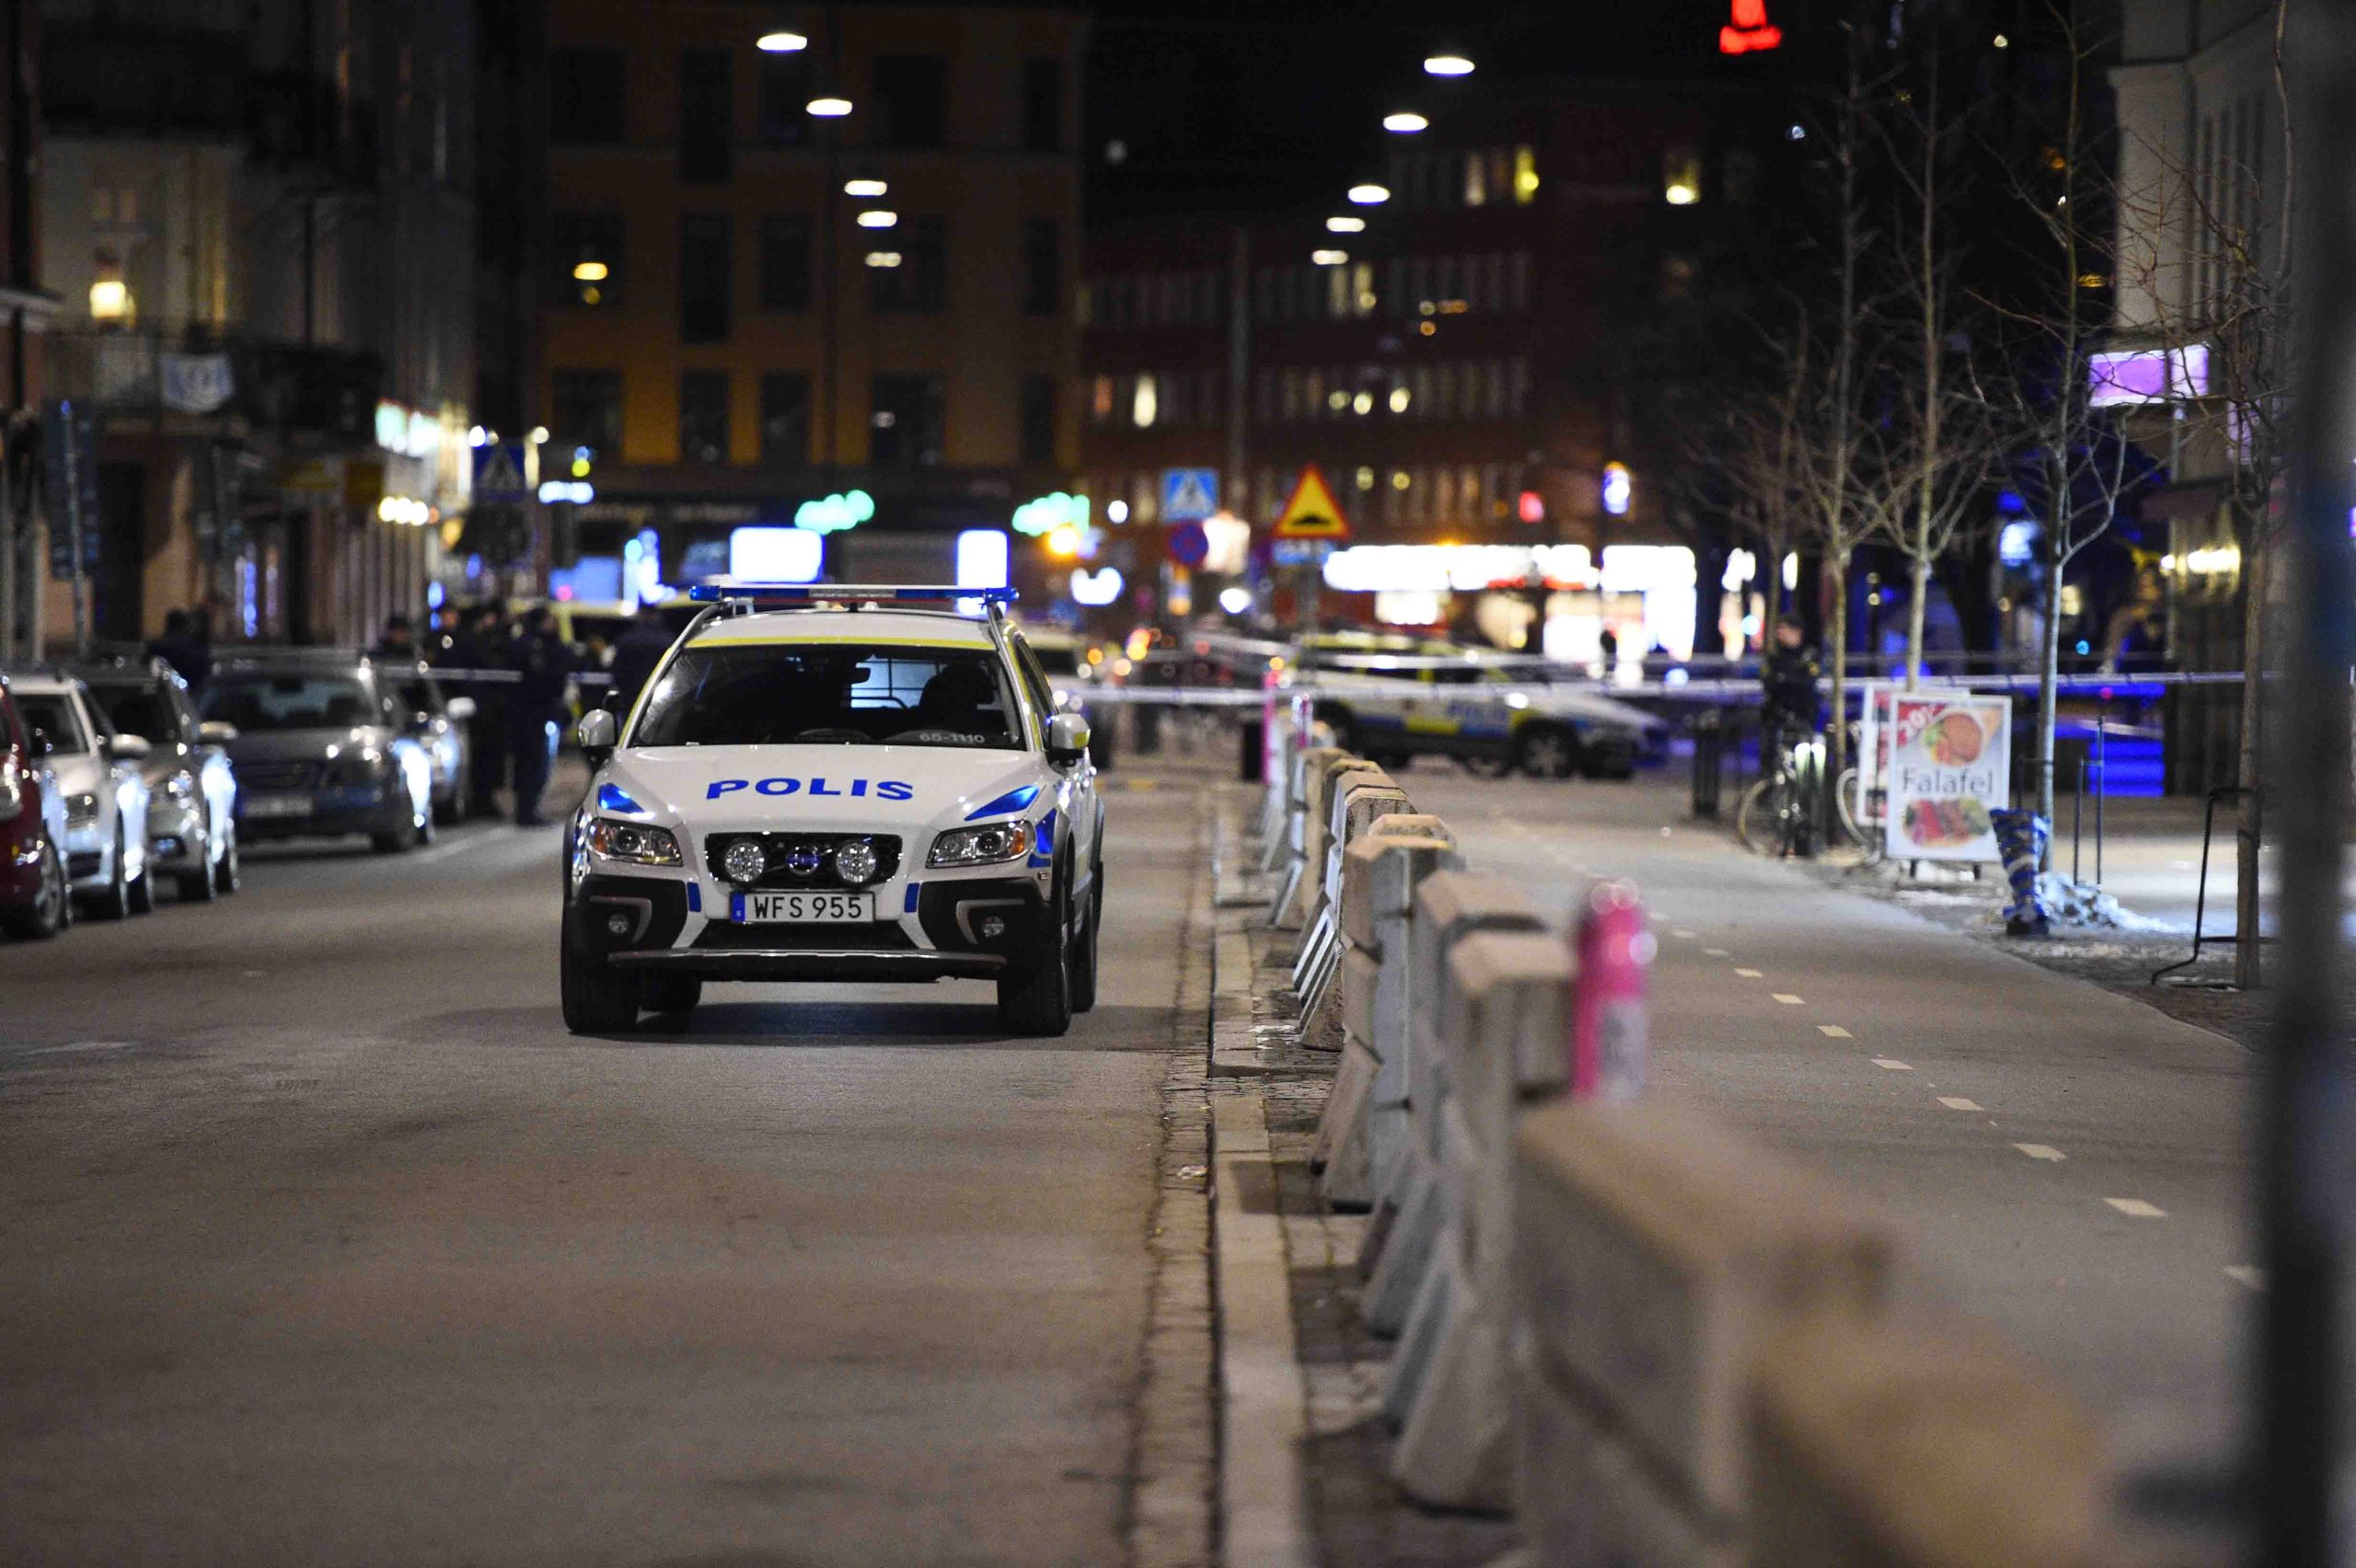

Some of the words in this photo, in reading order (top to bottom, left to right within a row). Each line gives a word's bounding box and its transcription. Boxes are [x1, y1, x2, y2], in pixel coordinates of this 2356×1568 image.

[707, 778, 913, 801] POLIS
[1902, 767, 1992, 793] Falafel
[754, 896, 803, 918] WFS
[812, 896, 861, 918] 955
